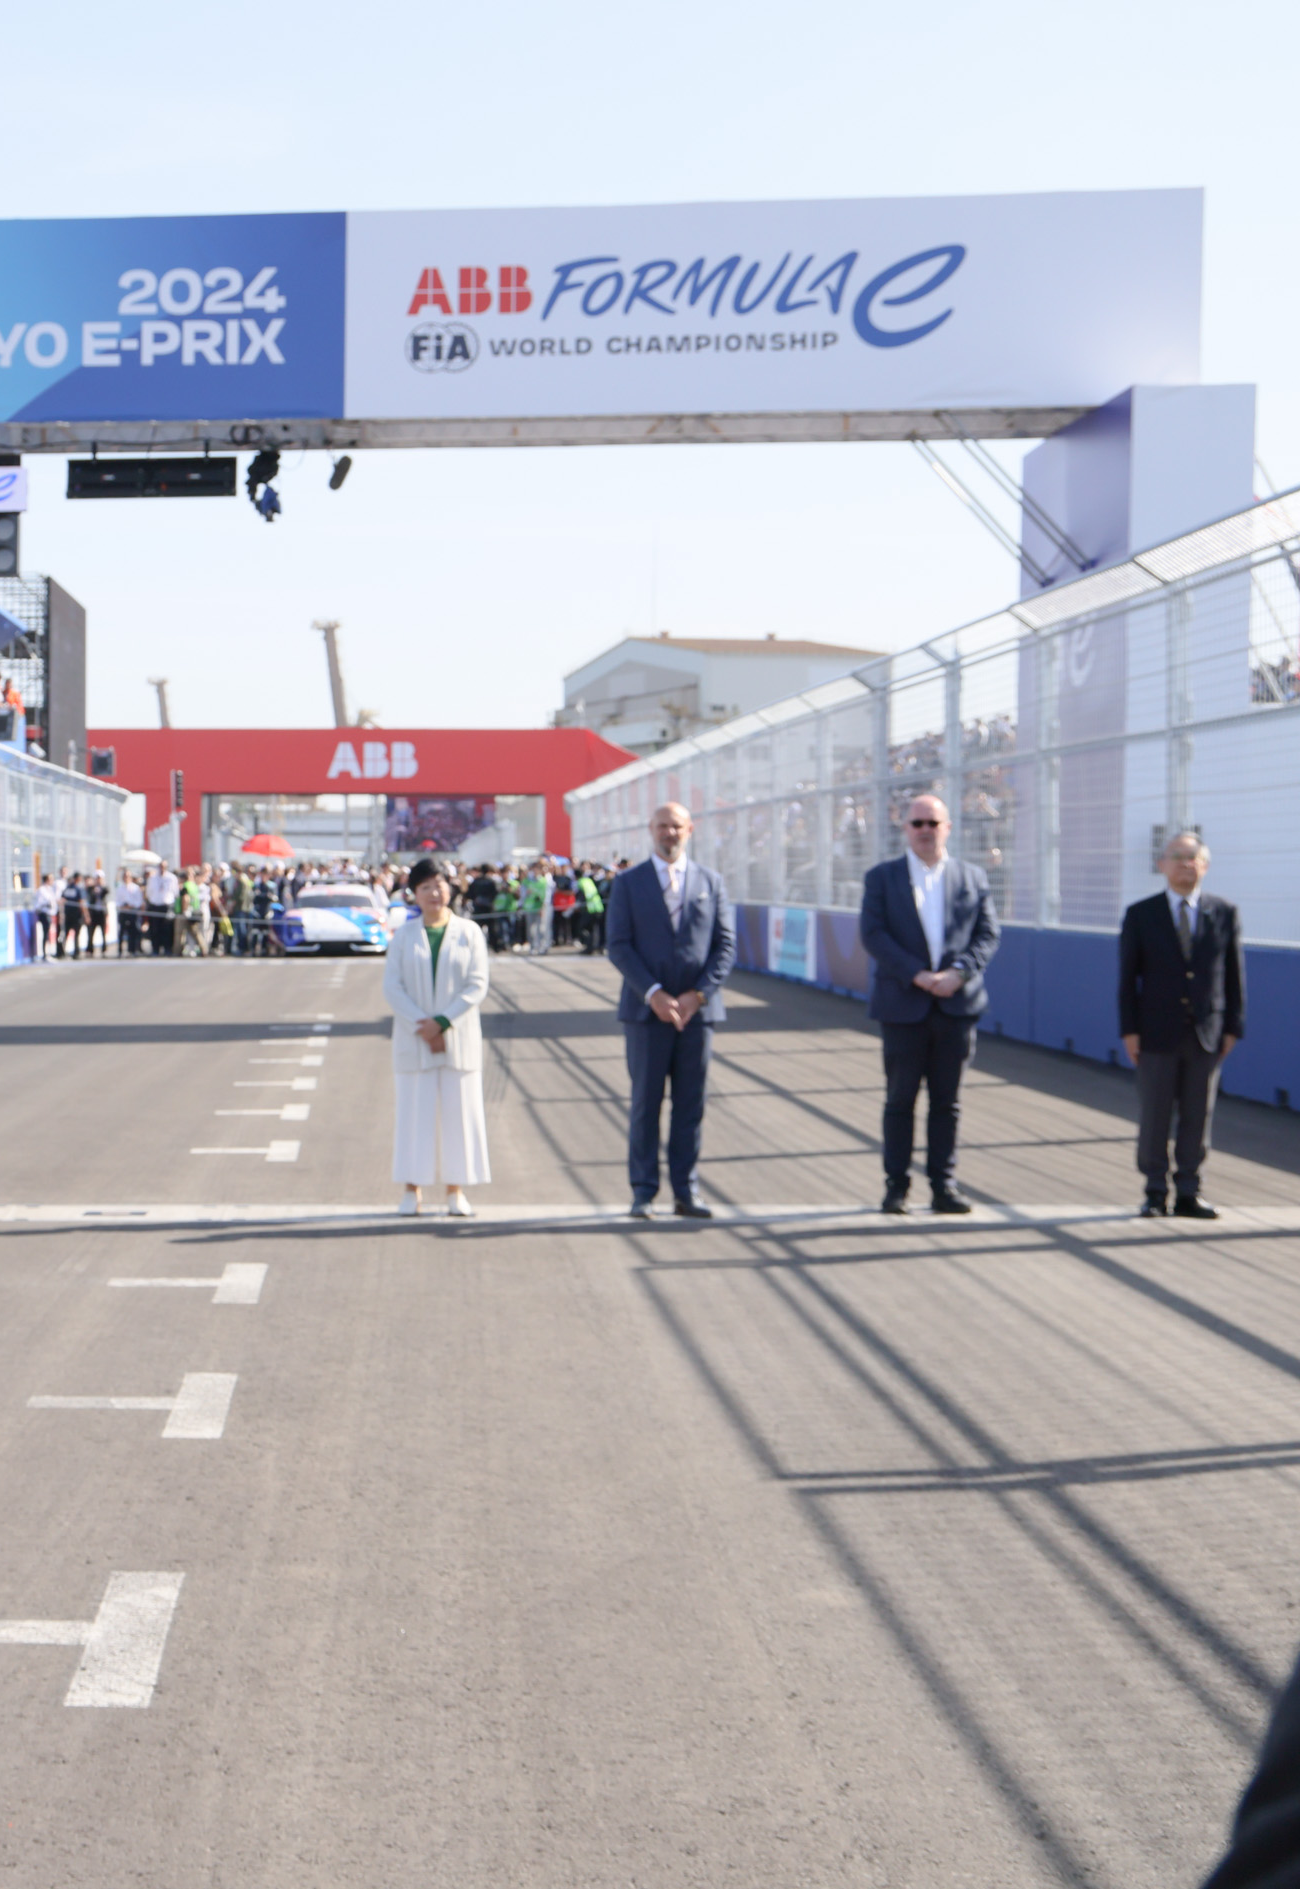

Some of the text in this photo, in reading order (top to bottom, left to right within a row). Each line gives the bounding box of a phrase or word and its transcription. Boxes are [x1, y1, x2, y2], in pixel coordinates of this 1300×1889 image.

[118, 267, 287, 316] 2024
[406, 266, 534, 316] ABB
[541, 250, 860, 322] FORMULA
[81, 318, 287, 368] E-PRIX
[489, 336, 594, 357] WORLD
[606, 331, 840, 356] CHAMPIONSHIP
[326, 741, 420, 780] ABB
